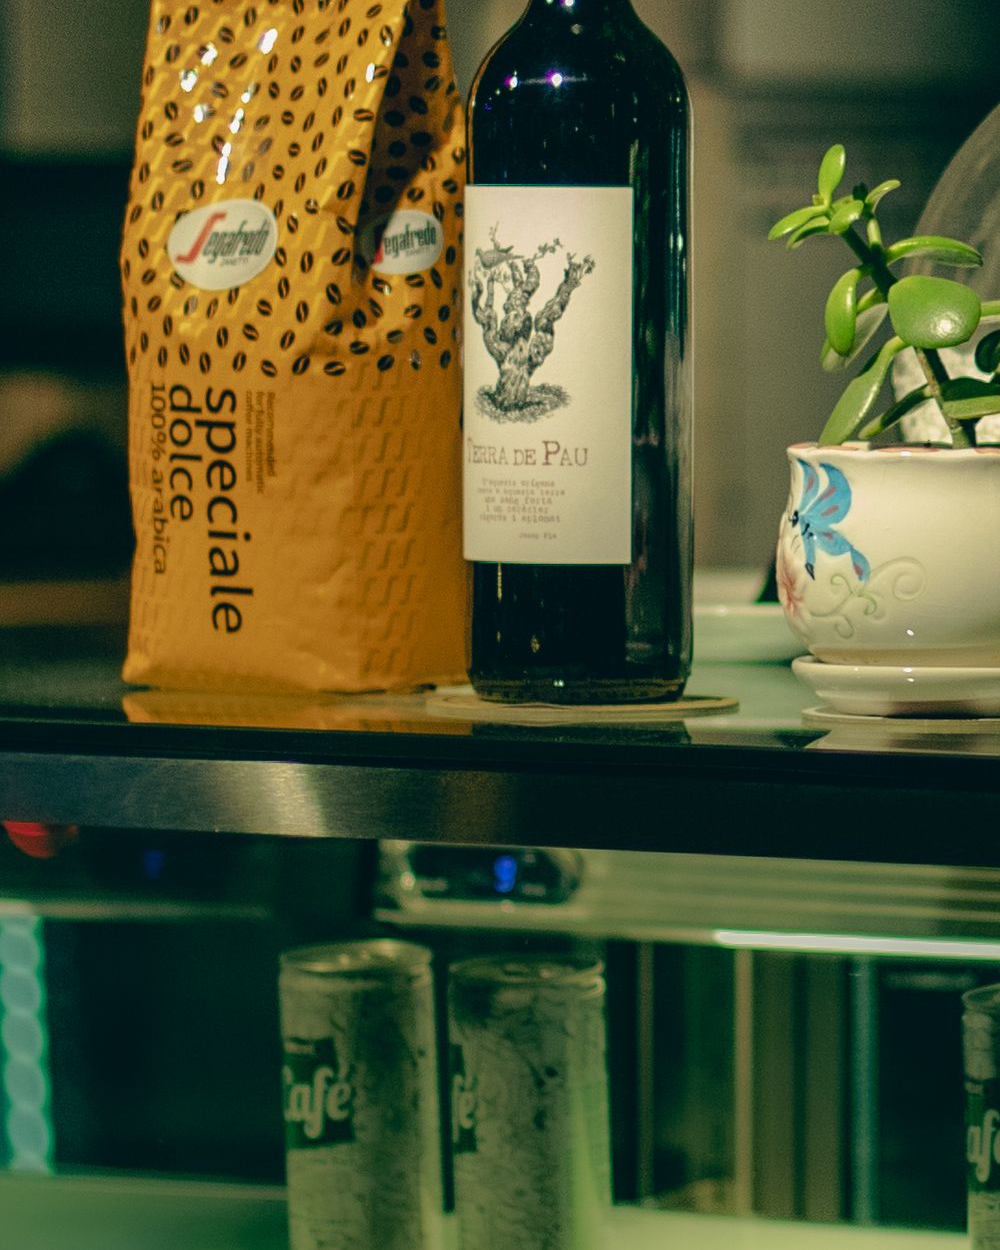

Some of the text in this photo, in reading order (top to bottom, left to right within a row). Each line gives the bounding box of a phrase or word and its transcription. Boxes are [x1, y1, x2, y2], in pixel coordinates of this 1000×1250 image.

[374, 220, 437, 265] egafredo
[150, 381, 170, 575] 100% arabica
[168, 383, 203, 522] dolce
[194, 386, 254, 634] speciale
